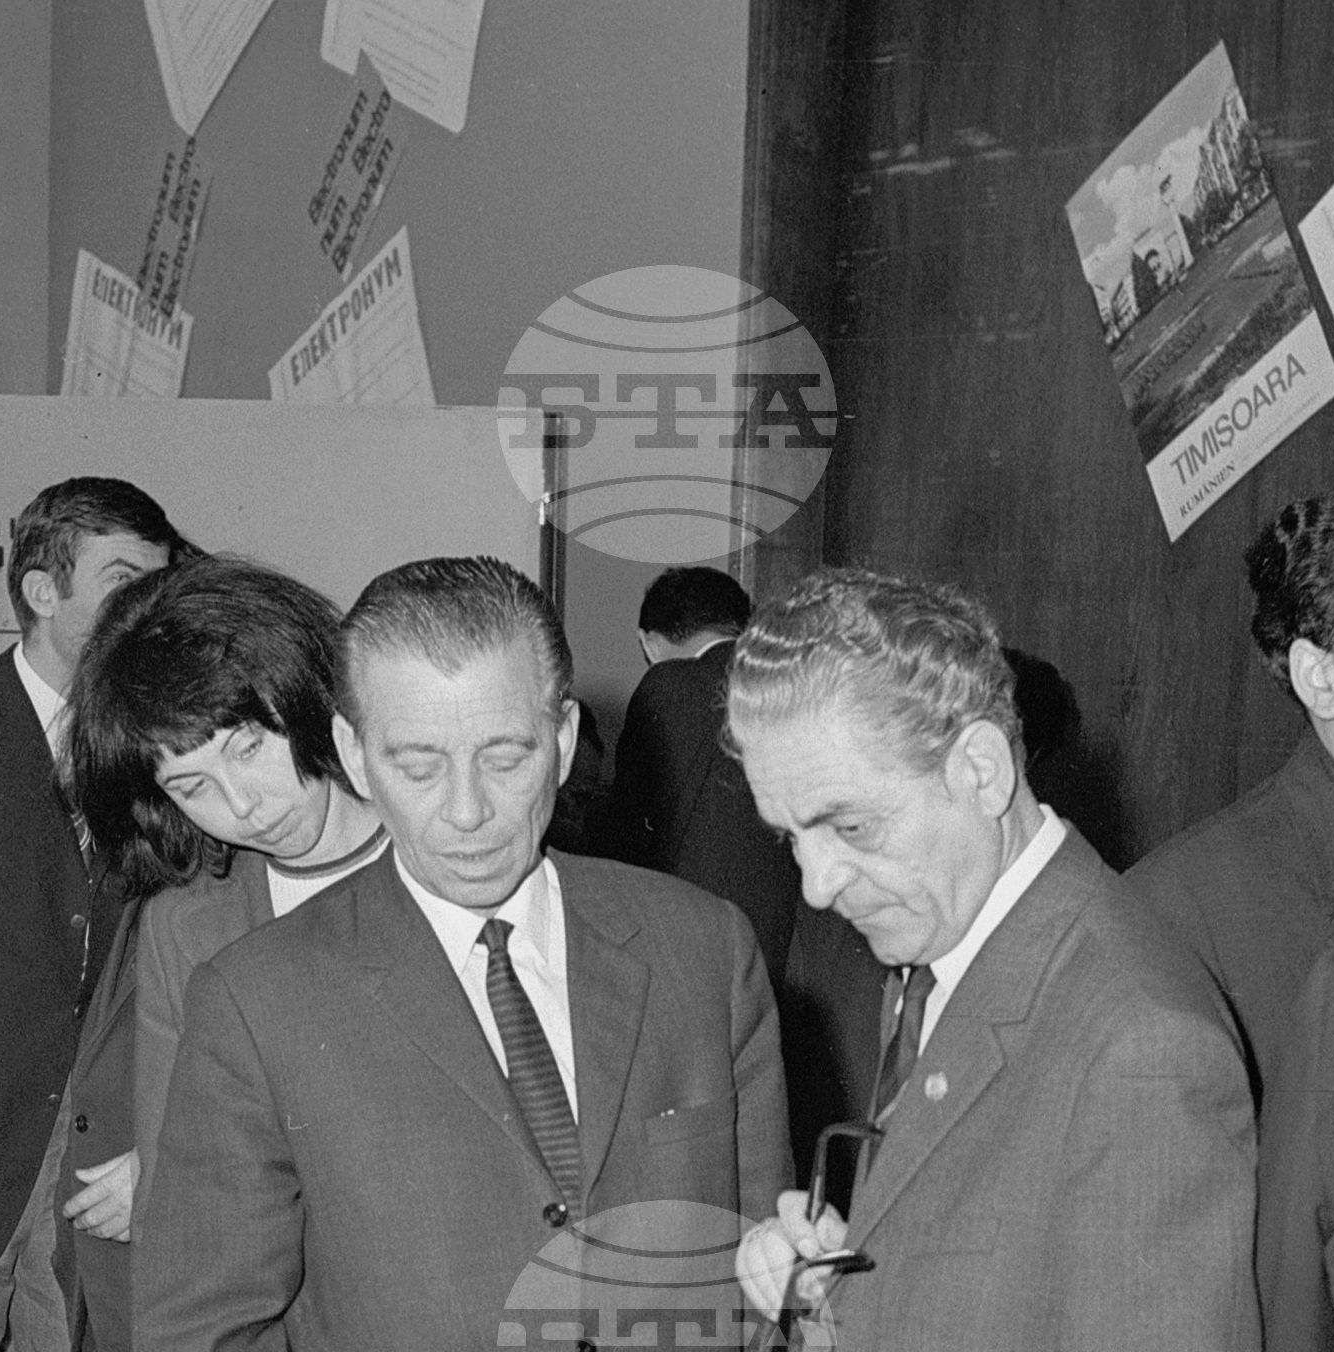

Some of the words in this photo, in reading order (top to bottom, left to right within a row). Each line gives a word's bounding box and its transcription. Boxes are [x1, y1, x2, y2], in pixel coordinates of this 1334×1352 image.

[306, 88, 369, 226] Electronum
[329, 137, 394, 274] Electronum
[291, 248, 403, 386] ЕЛЕКТРОНУМ
